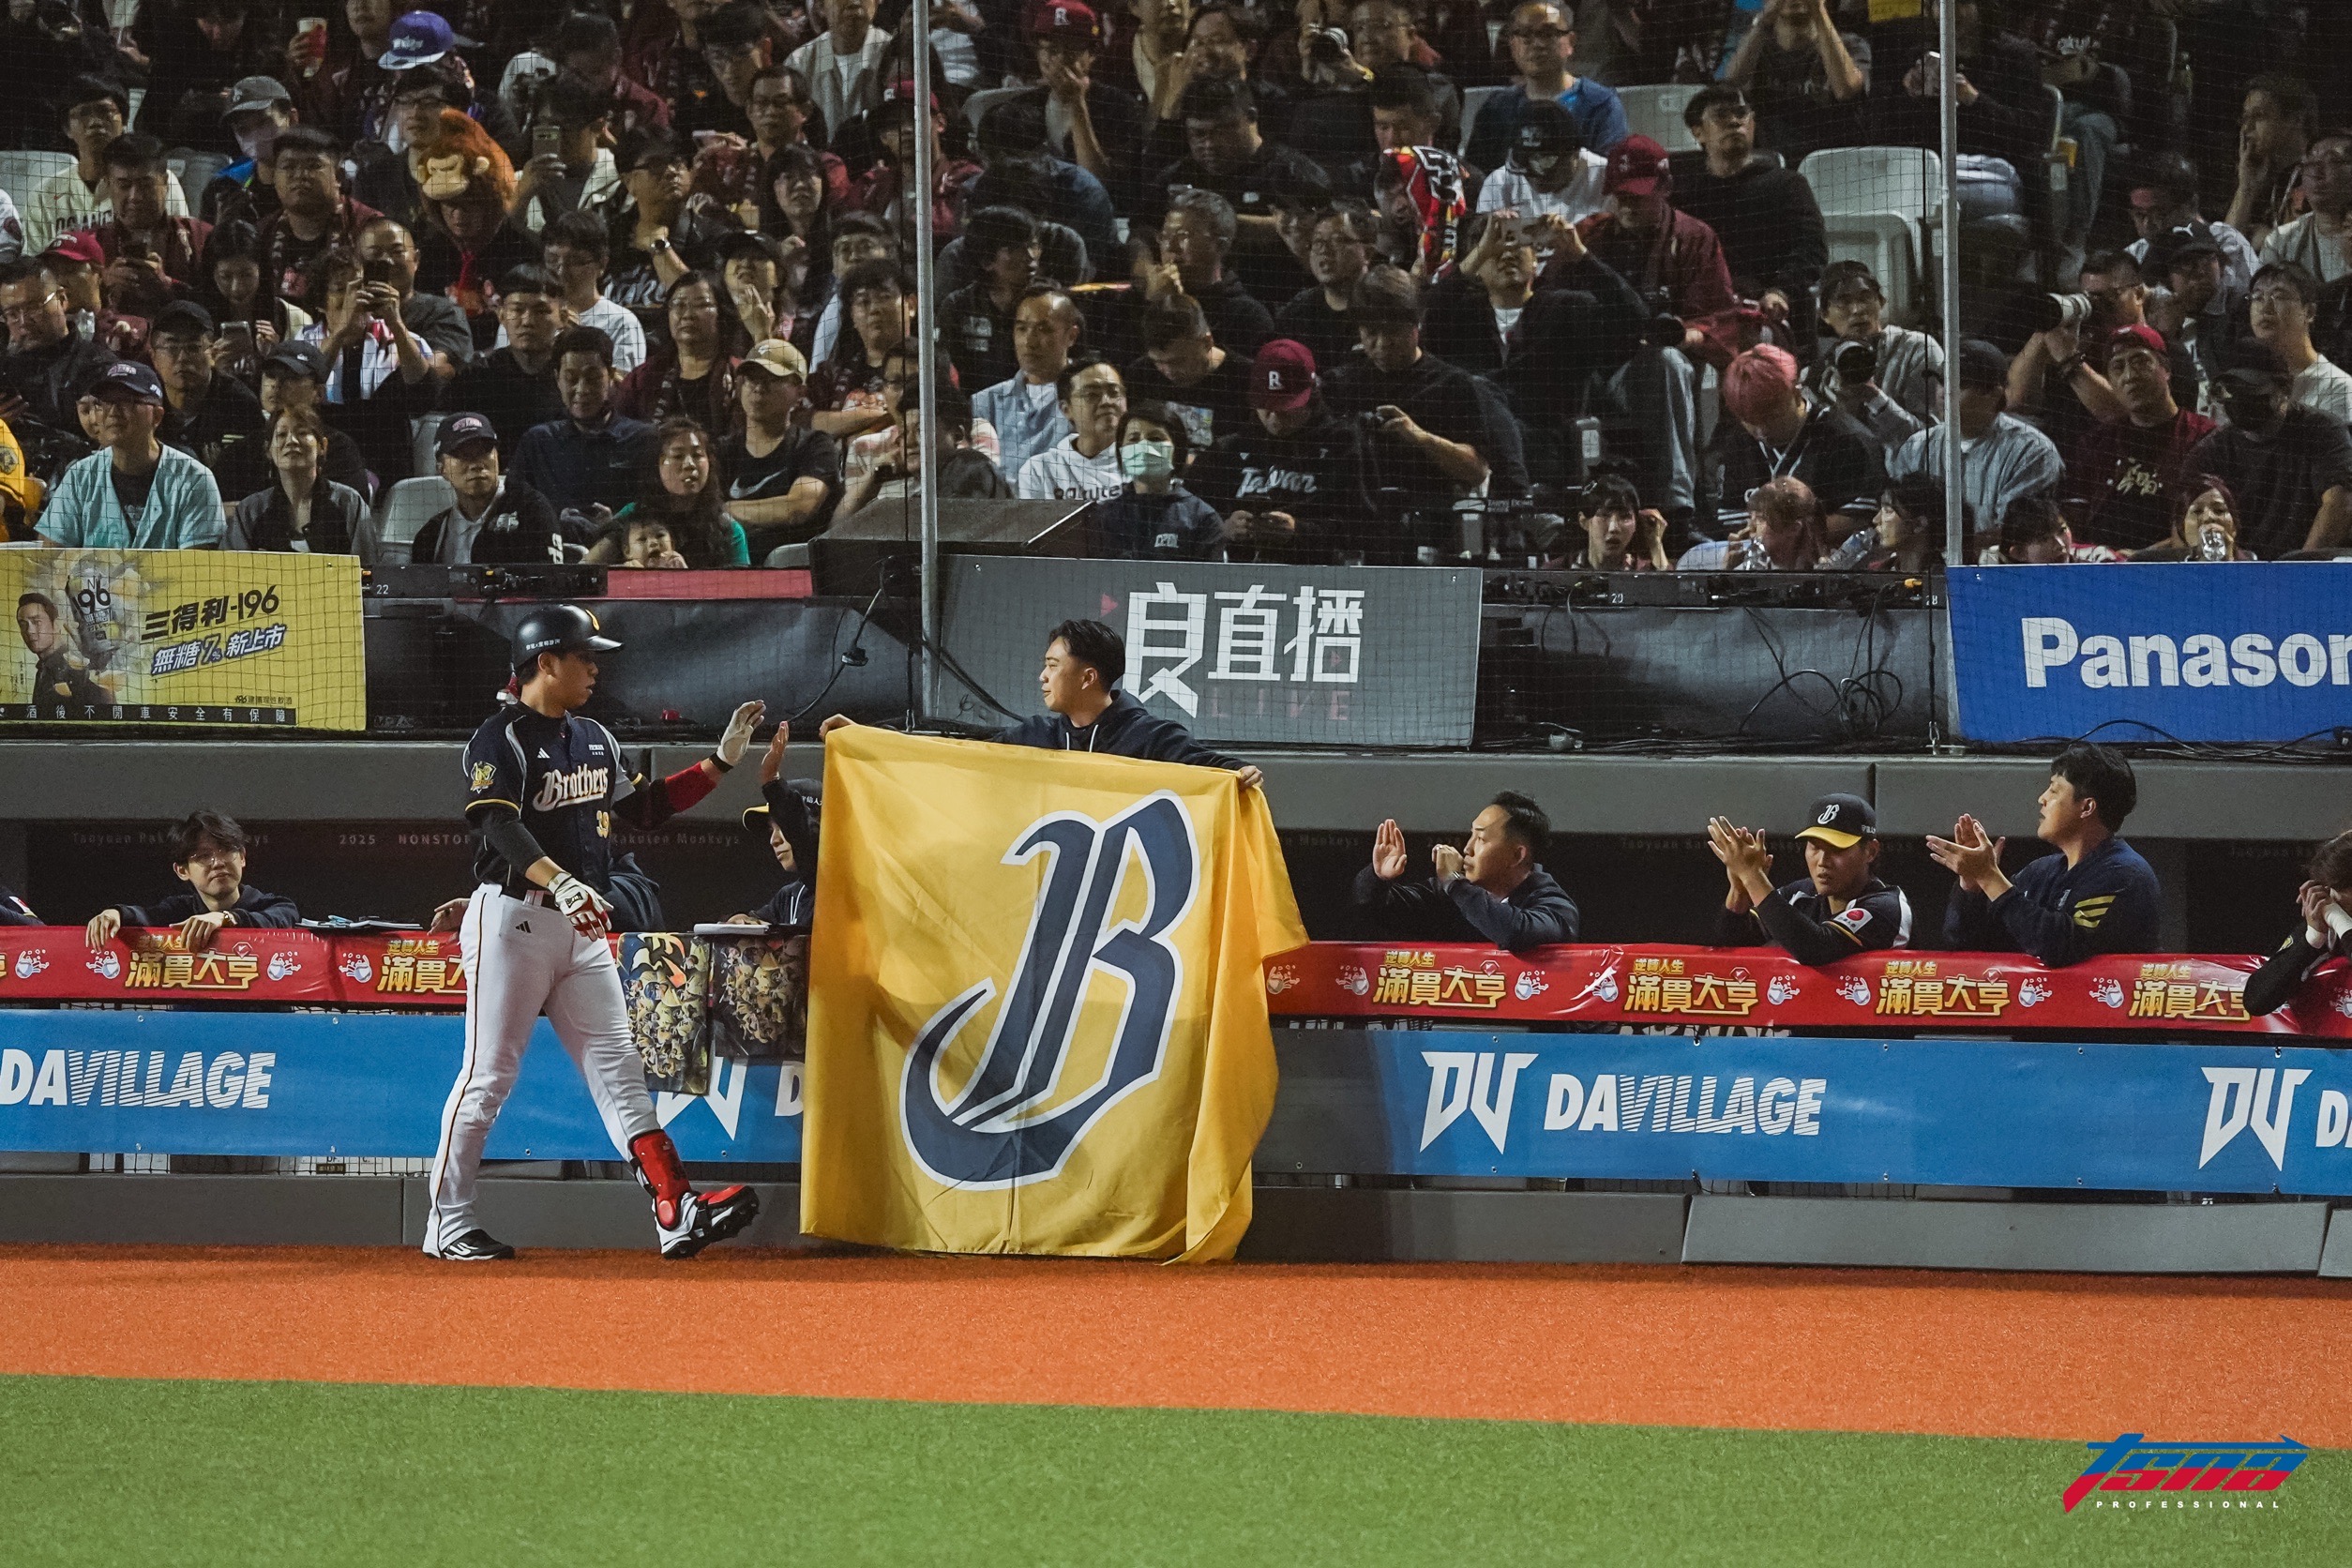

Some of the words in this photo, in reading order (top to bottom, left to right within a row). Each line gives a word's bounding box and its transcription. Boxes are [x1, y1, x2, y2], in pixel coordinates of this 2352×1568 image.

[1268, 370, 1283, 390] R
[1052, 483, 1121, 503] rakute
[376, 584, 389, 595] 22
[533, 763, 609, 812] Brothers
[1817, 804, 1840, 825] B
[339, 834, 376, 846] 2025
[900, 789, 1200, 1192] B
[1372, 967, 1508, 1010] 滿貫大亨
[1622, 973, 1760, 1017] 滿貫大亨
[1876, 974, 2011, 1018] 滿貫大亨
[0, 1048, 277, 1110] DAVILLAGE
[1544, 1074, 1827, 1136] DAVILLAGE
